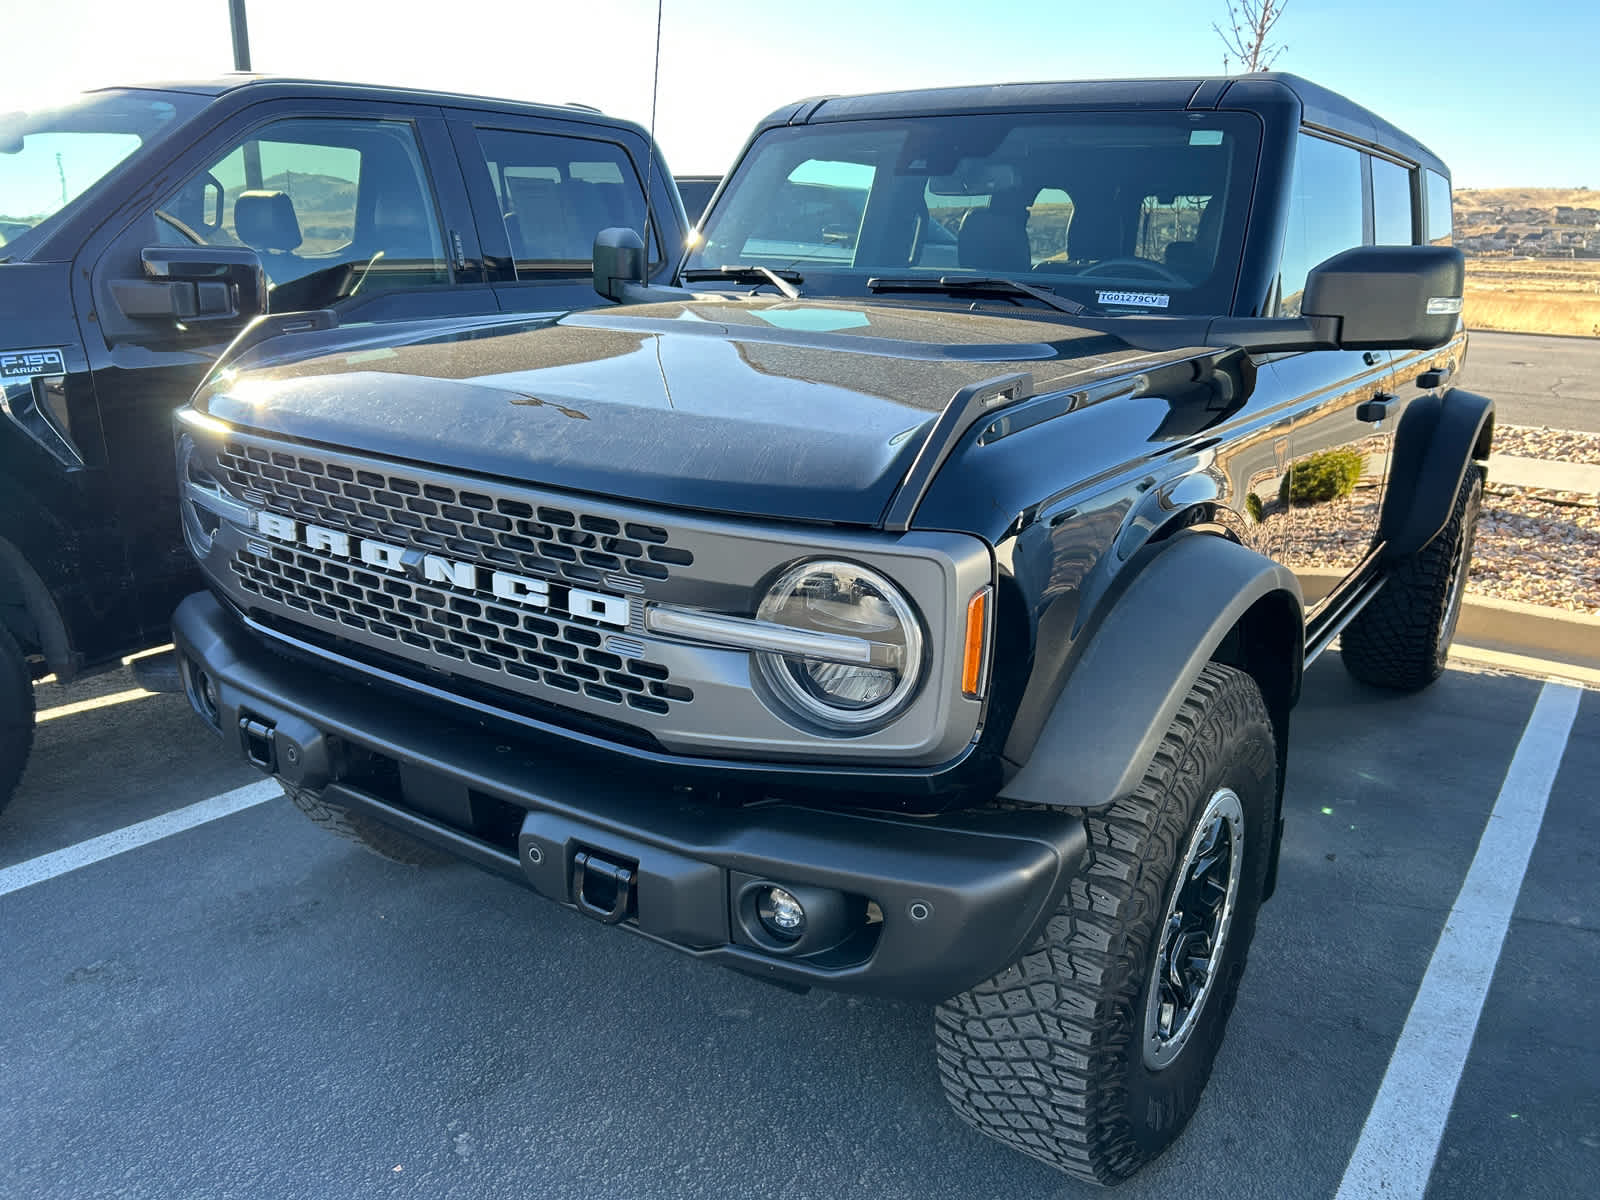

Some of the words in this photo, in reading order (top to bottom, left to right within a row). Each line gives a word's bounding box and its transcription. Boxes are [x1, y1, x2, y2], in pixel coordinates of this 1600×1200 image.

[1101, 293, 1158, 303] TG01279CV
[1, 353, 60, 367] F-150
[5, 366, 43, 375] LARIAT
[257, 510, 630, 626] BRONCO
